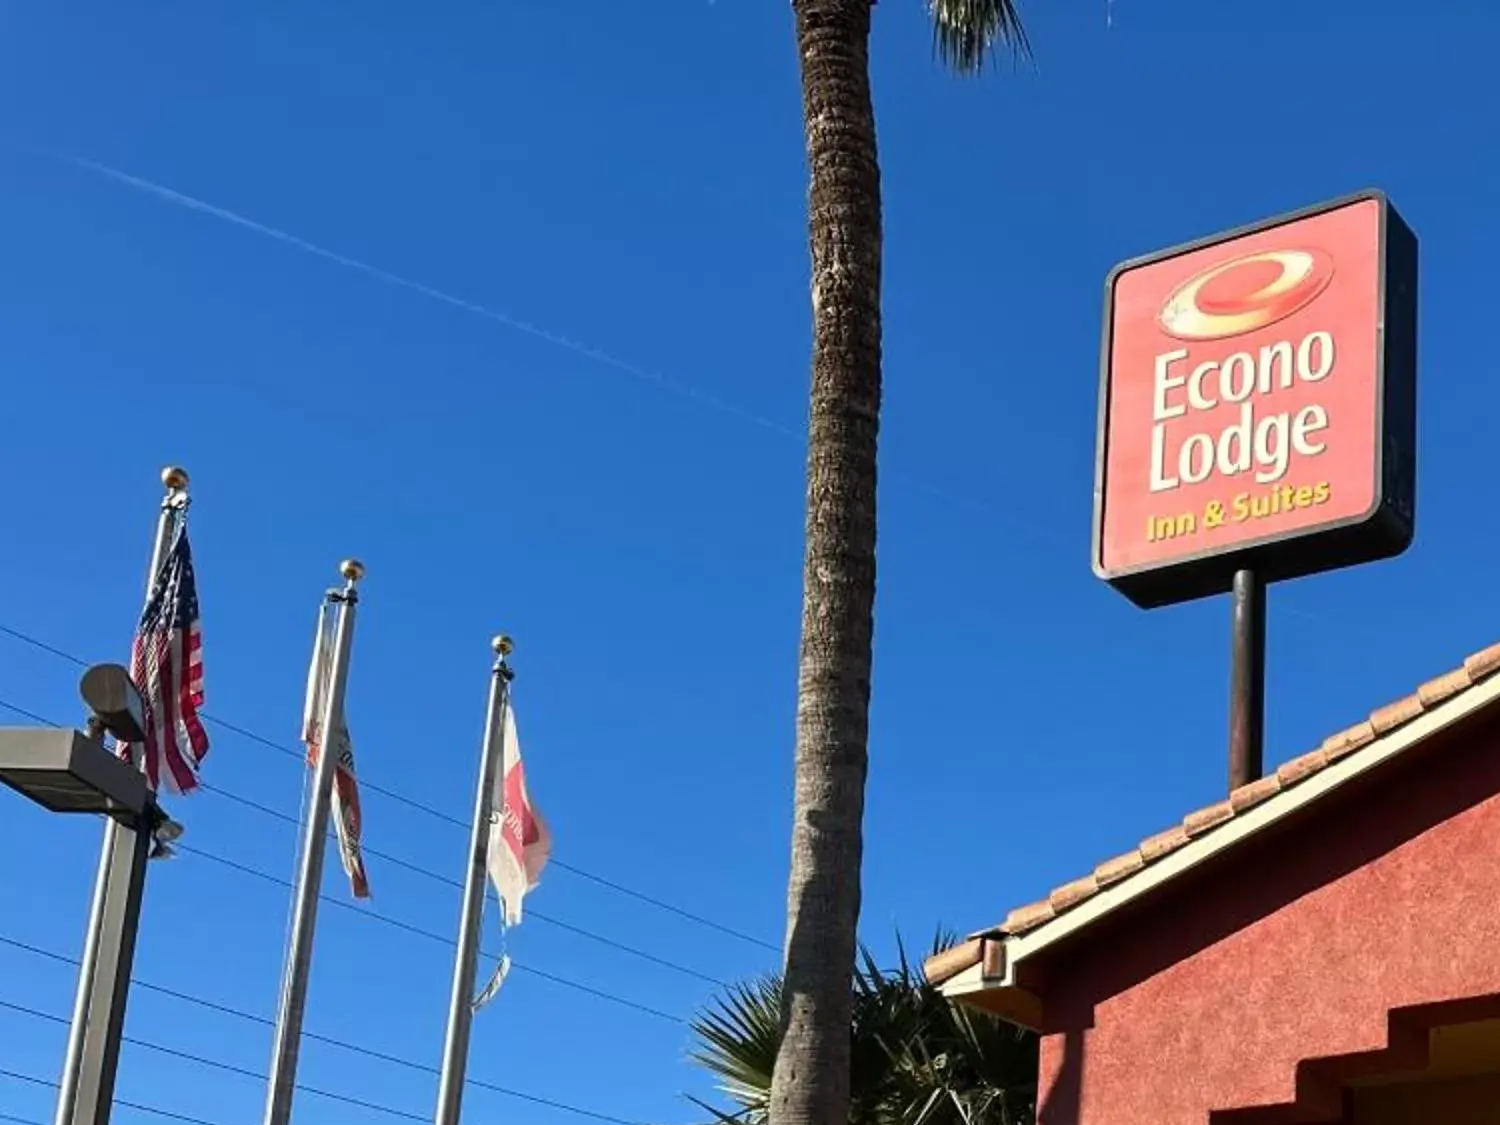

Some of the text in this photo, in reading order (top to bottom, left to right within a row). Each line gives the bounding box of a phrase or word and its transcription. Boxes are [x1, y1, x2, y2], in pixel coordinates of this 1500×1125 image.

[1153, 331, 1334, 421] Econo
[1150, 402, 1329, 492] Lodge
[1146, 481, 1331, 542] Inn & Suites
